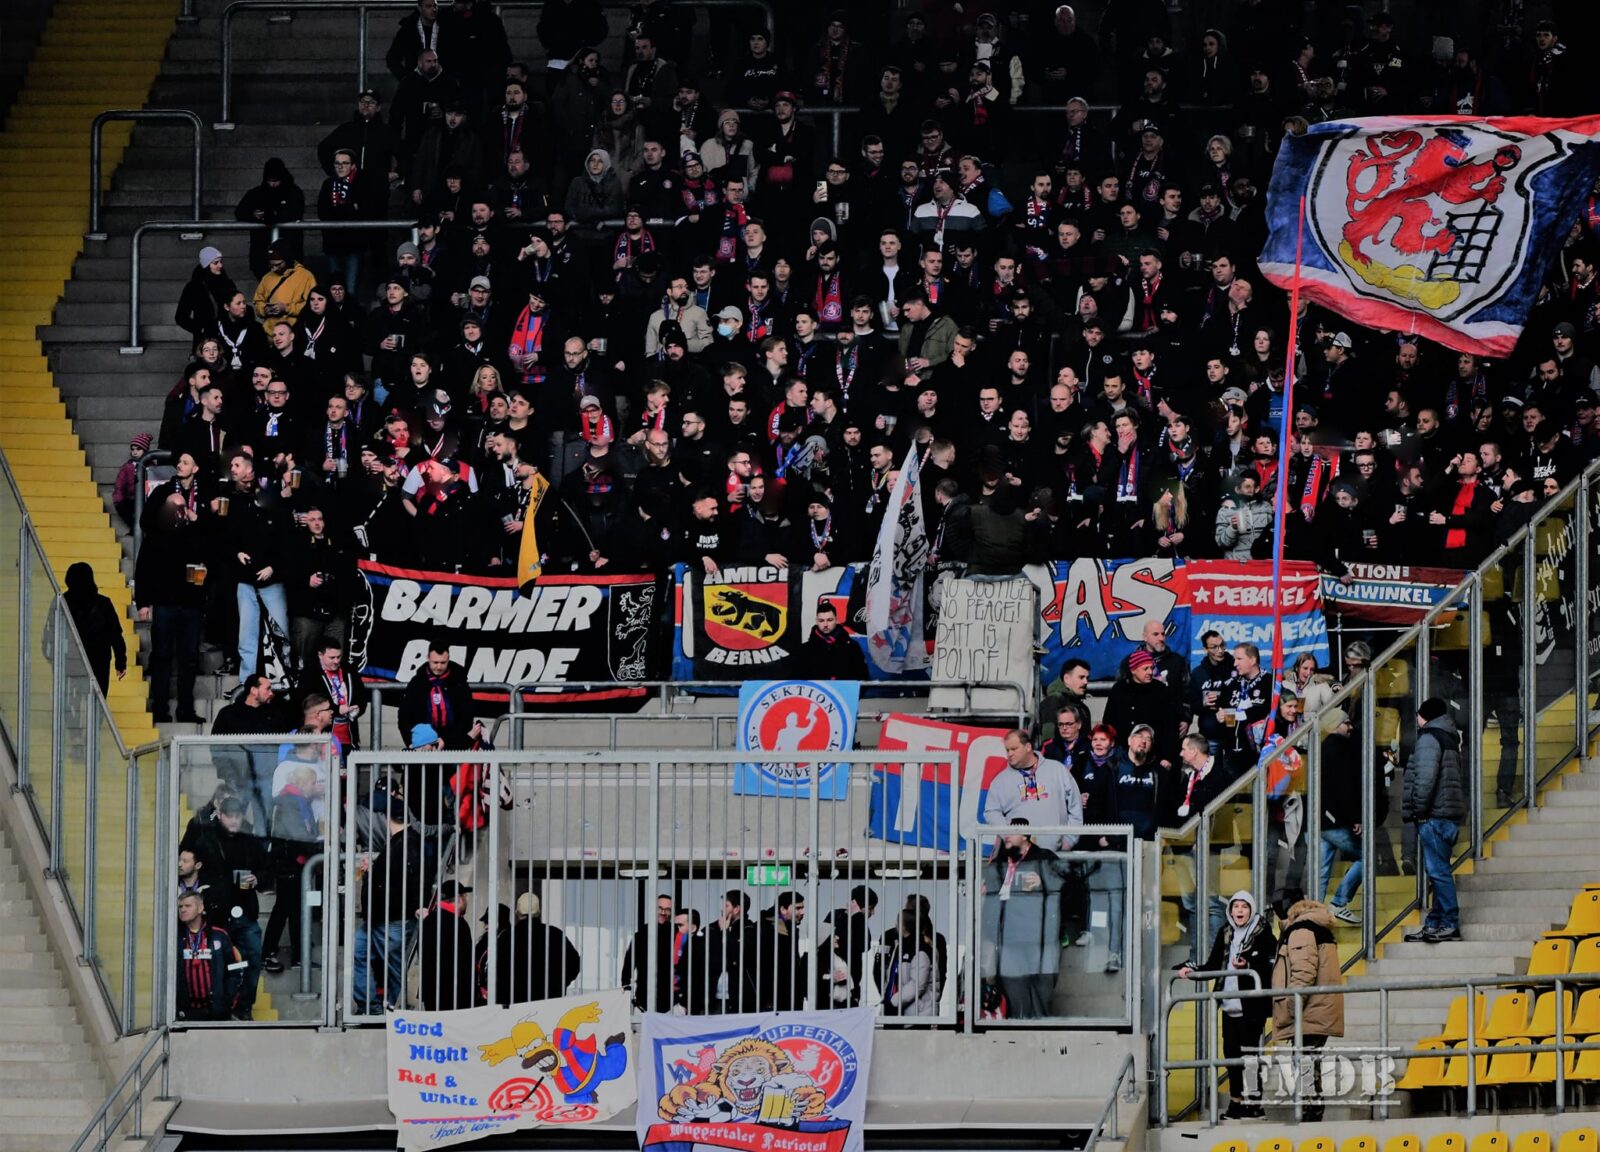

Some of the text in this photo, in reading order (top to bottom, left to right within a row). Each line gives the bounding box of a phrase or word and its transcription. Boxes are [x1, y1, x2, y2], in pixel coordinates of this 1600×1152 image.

[703, 566, 788, 584] AMICI
[941, 579, 959, 599] NO
[1323, 580, 1432, 603] VOHWINKEL
[381, 579, 602, 633] BARMER
[941, 599, 958, 619] NO
[982, 623, 997, 649] IS
[704, 645, 790, 665] BERNA
[761, 686, 836, 714] SEKTION
[409, 1044, 468, 1063] Night
[398, 1068, 458, 1087] Red &
[669, 1124, 828, 1151] Wuppertaler Patrioten
